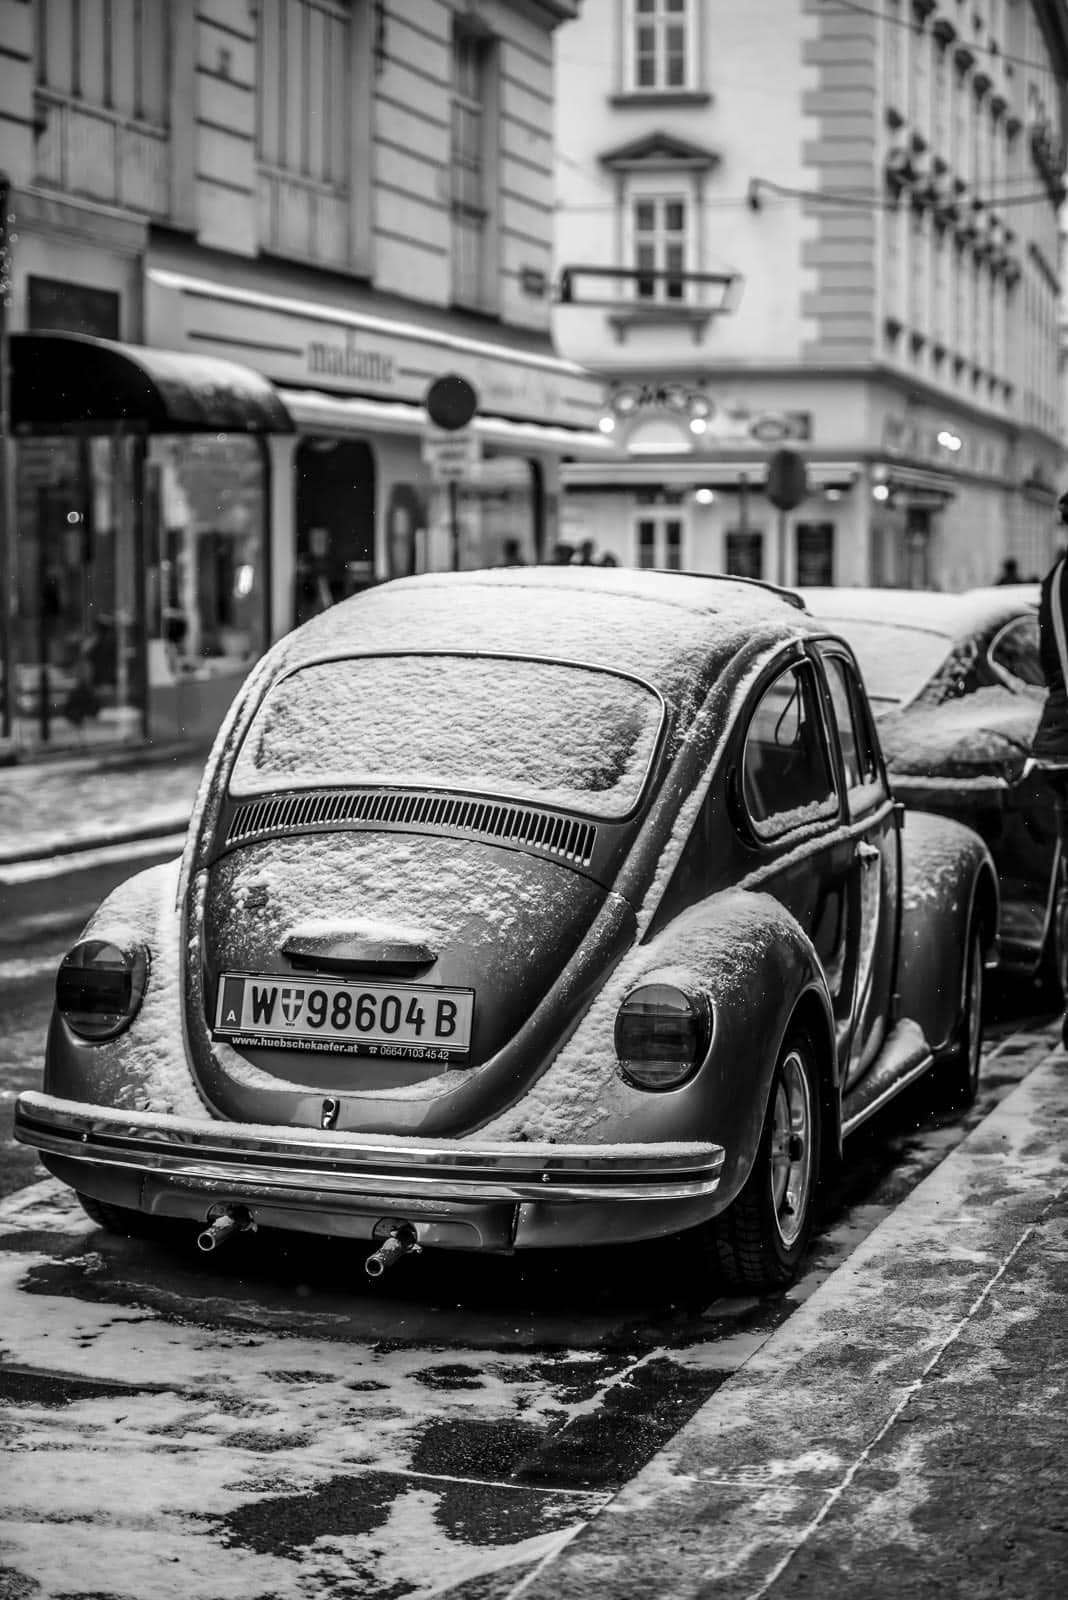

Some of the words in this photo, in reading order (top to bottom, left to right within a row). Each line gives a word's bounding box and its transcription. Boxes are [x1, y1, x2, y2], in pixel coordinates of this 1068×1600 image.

[307, 329, 395, 384] madame
[226, 1009, 237, 1022] A
[252, 985, 278, 1025] W
[306, 989, 426, 1037] 98604
[435, 999, 458, 1037] B
[232, 1036, 359, 1053] www.huebschekaefer.at
